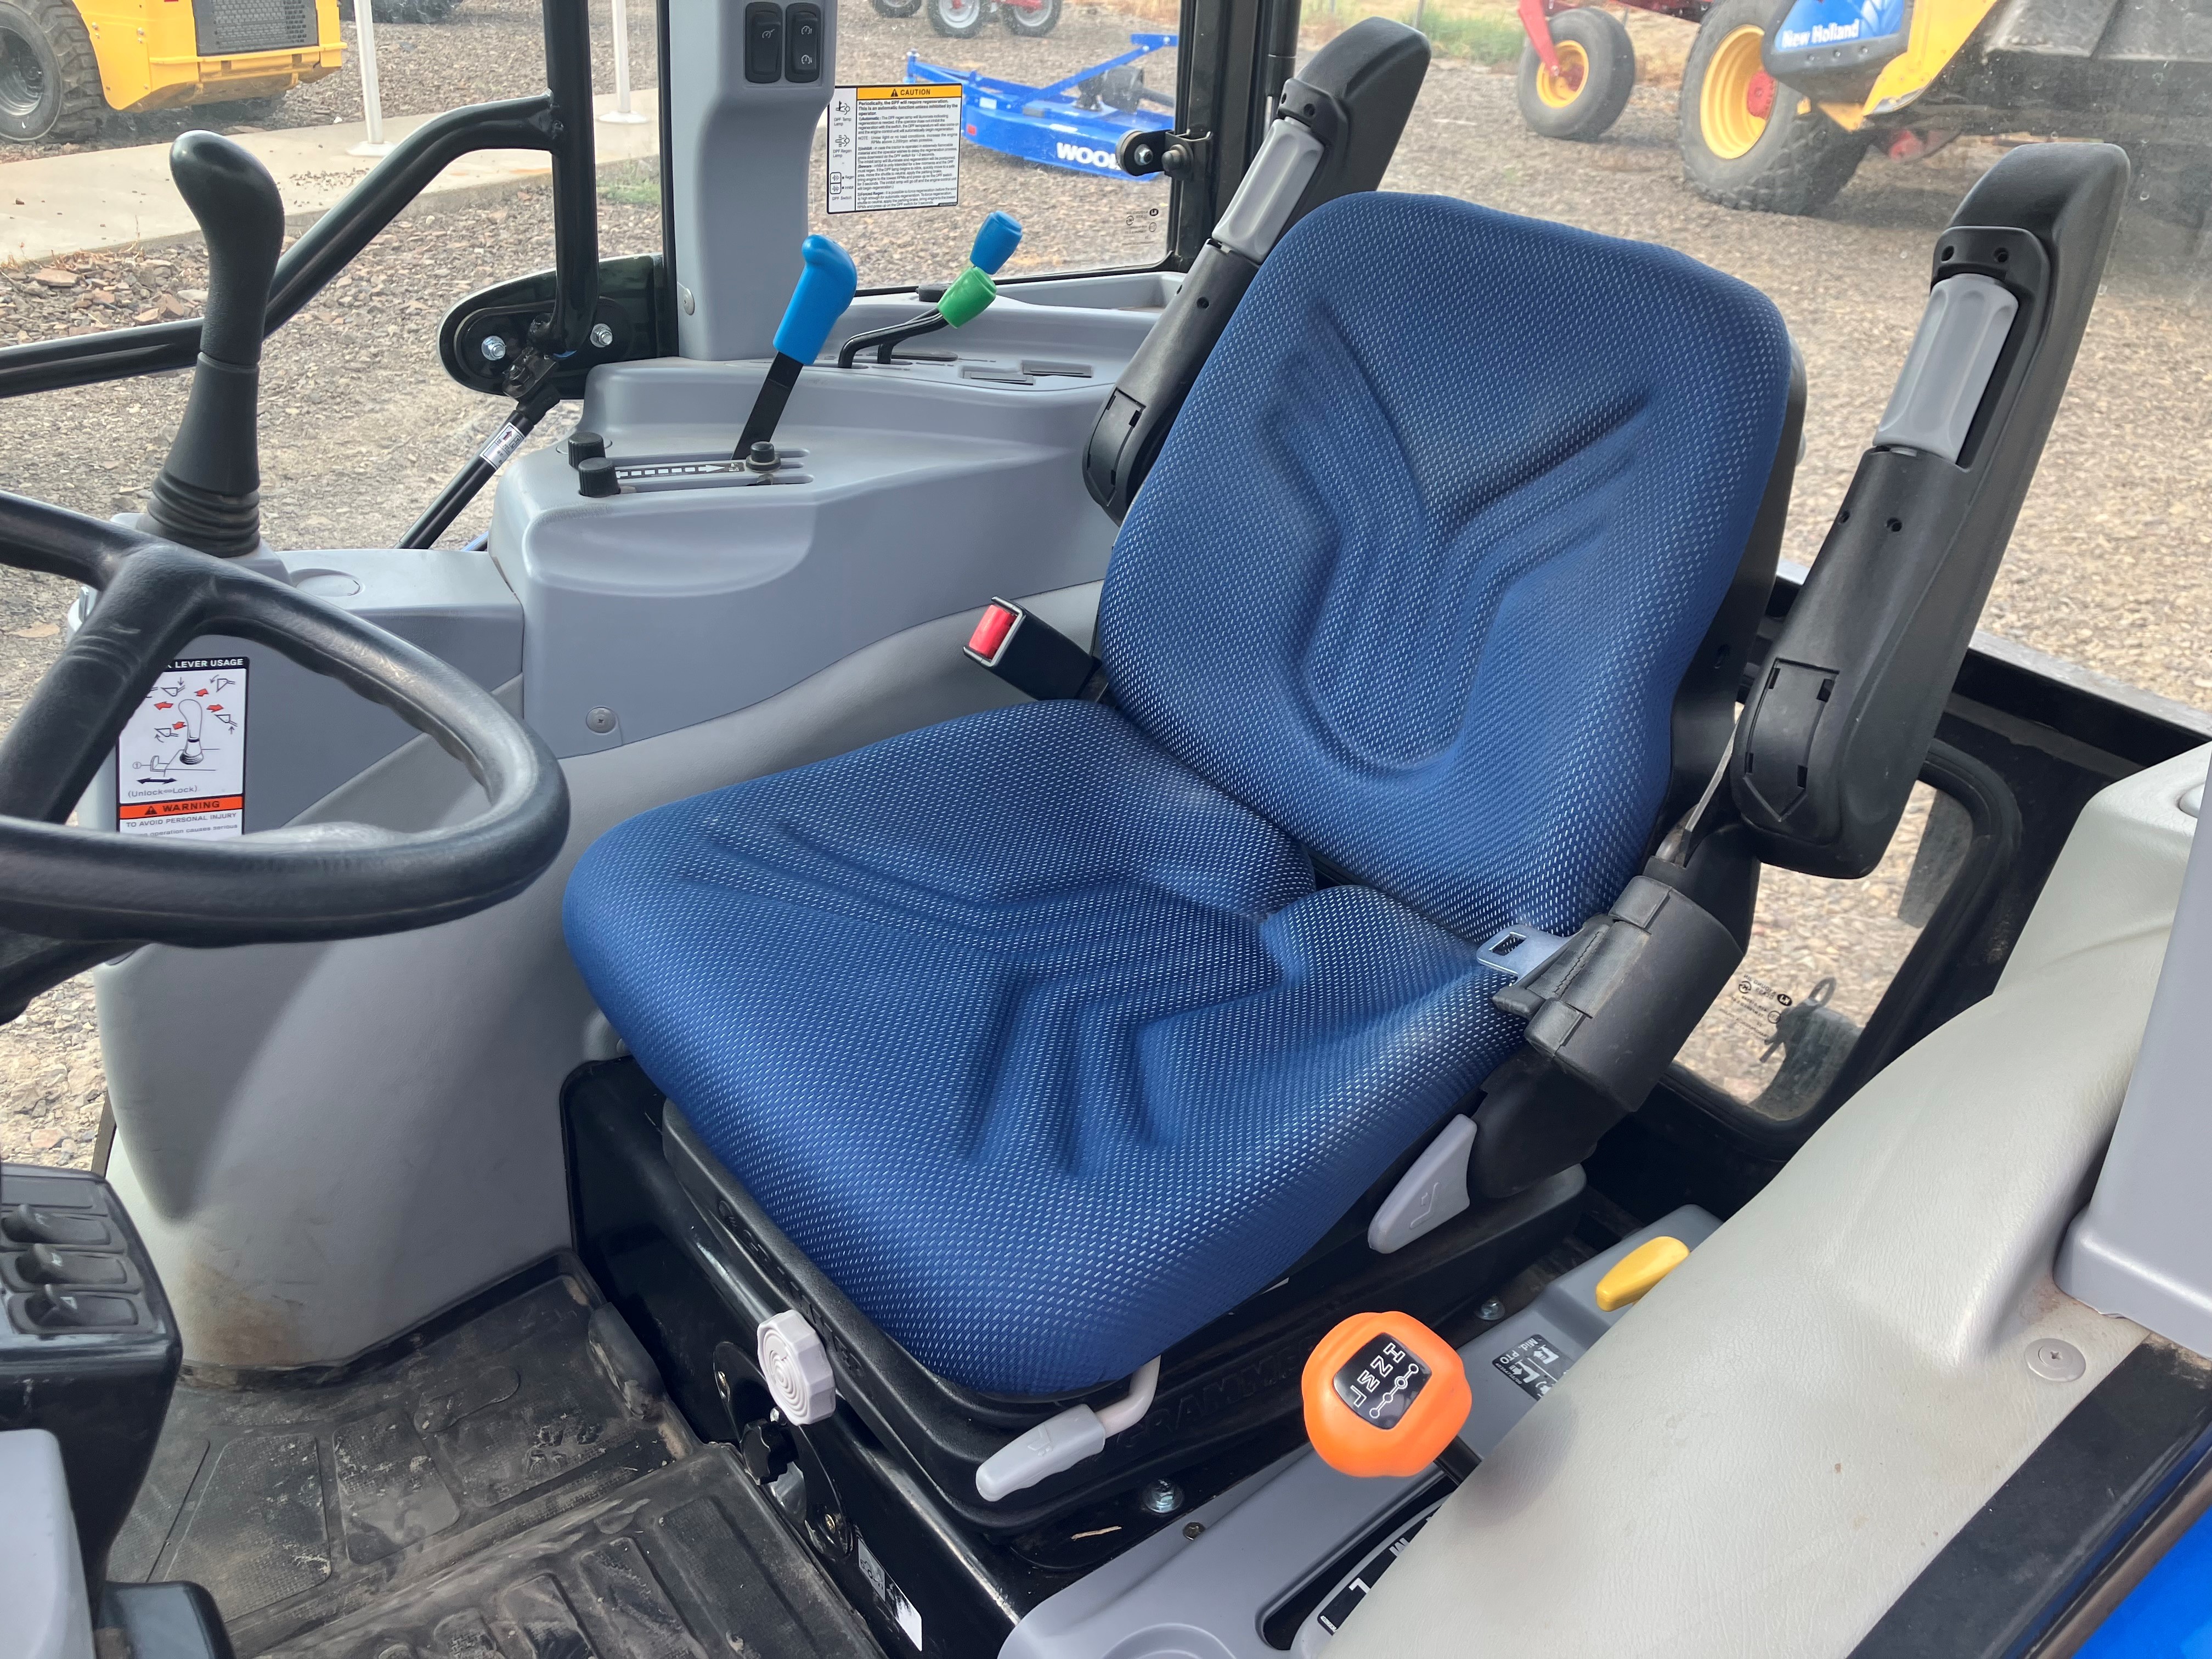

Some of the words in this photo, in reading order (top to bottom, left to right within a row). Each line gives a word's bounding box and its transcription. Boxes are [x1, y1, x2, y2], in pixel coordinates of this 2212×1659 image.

[1781, 29, 1810, 48] New
[1812, 18, 1859, 43] Holland
[1057, 142, 1122, 170] WOO
[175, 660, 207, 668] LEVER
[211, 658, 244, 667] USAGE
[162, 800, 220, 812] WARNING
[166, 815, 207, 823] PERSONAL
[1518, 1338, 1538, 1351] Mid.
[1499, 1350, 1520, 1364] PTO
